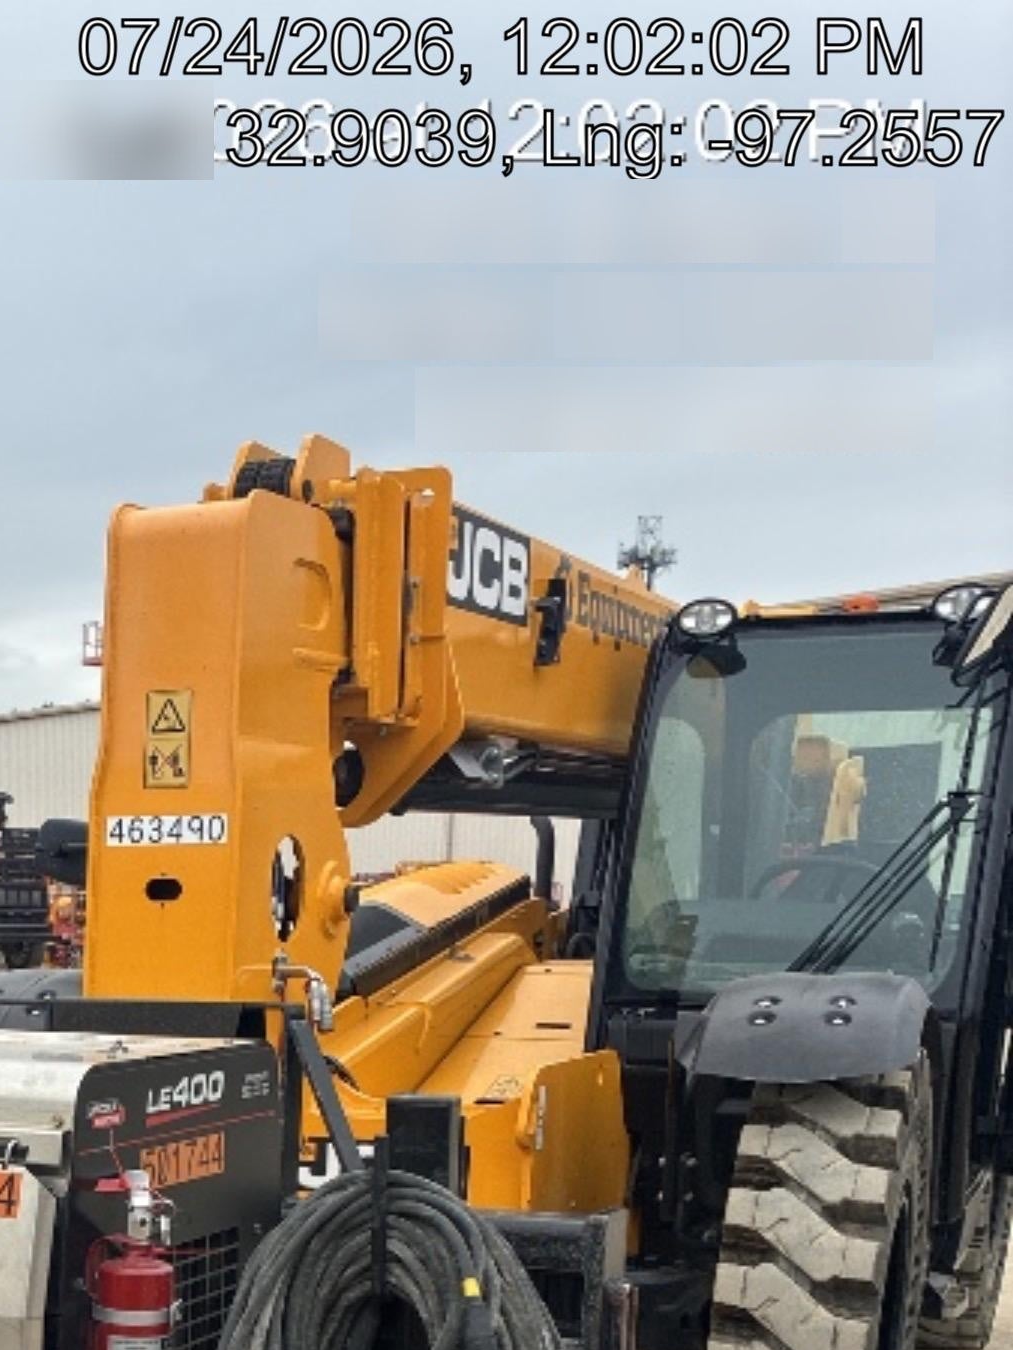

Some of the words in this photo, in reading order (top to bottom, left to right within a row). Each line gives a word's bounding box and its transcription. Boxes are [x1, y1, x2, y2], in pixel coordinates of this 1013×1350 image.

[447, 521, 528, 616] JCB
[109, 816, 226, 844] 463490
[146, 1070, 225, 1114] LE400
[143, 1131, 223, 1187] 501744
